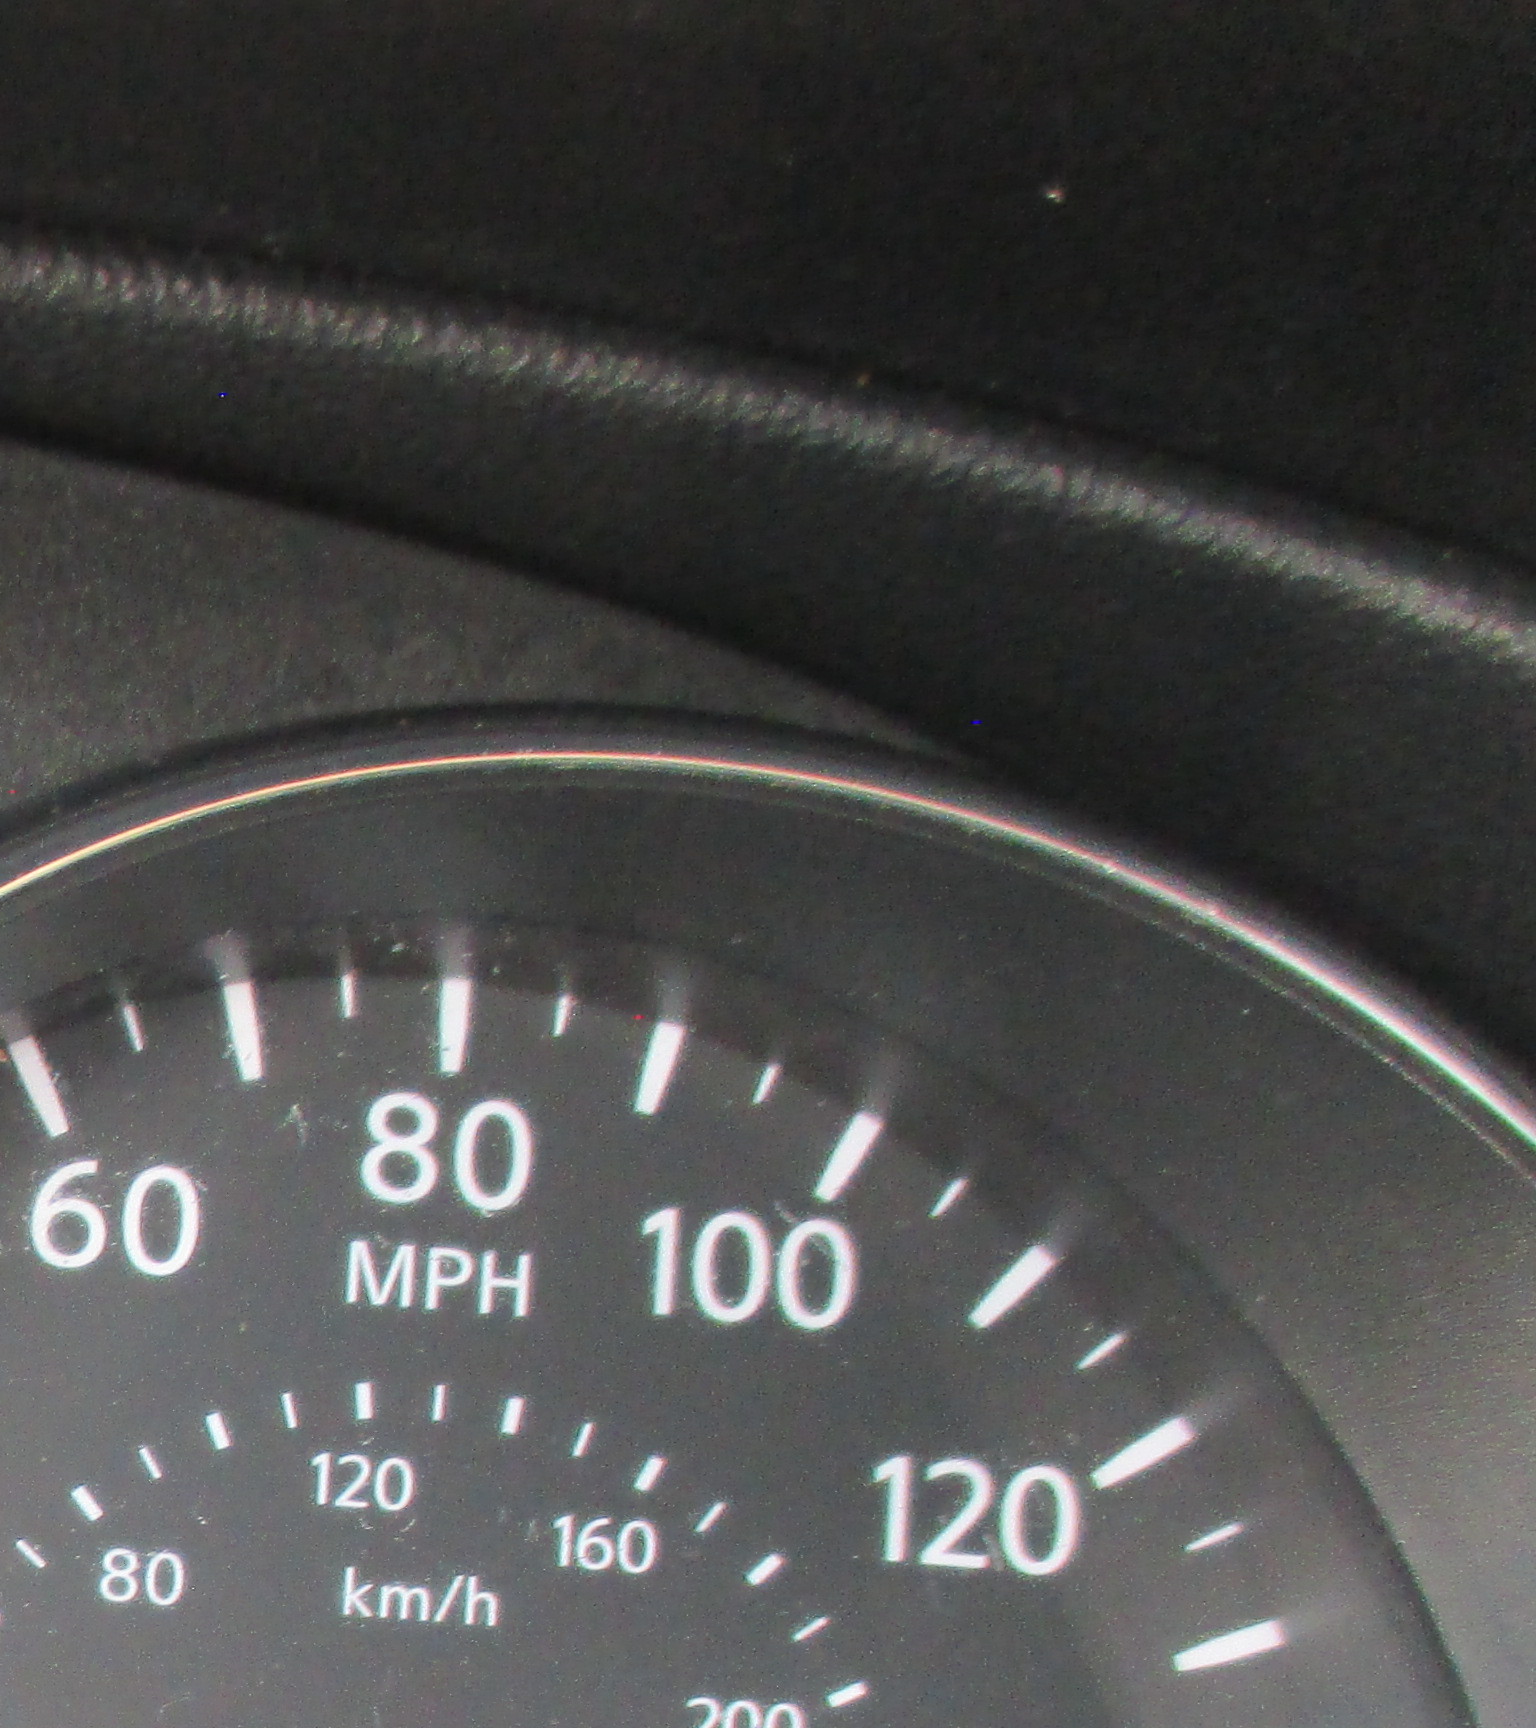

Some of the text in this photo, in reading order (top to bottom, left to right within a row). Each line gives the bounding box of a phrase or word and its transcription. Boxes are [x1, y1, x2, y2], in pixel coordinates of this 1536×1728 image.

[362, 1092, 531, 1214] 80
[31, 1160, 199, 1276] 60
[348, 1240, 530, 1316] MPH
[644, 1208, 854, 1329] 100
[313, 1453, 413, 1511] 120
[877, 1456, 1079, 1575] 120
[100, 1548, 184, 1606] 80
[556, 1515, 656, 1574] 160
[343, 1567, 498, 1626] km/h
